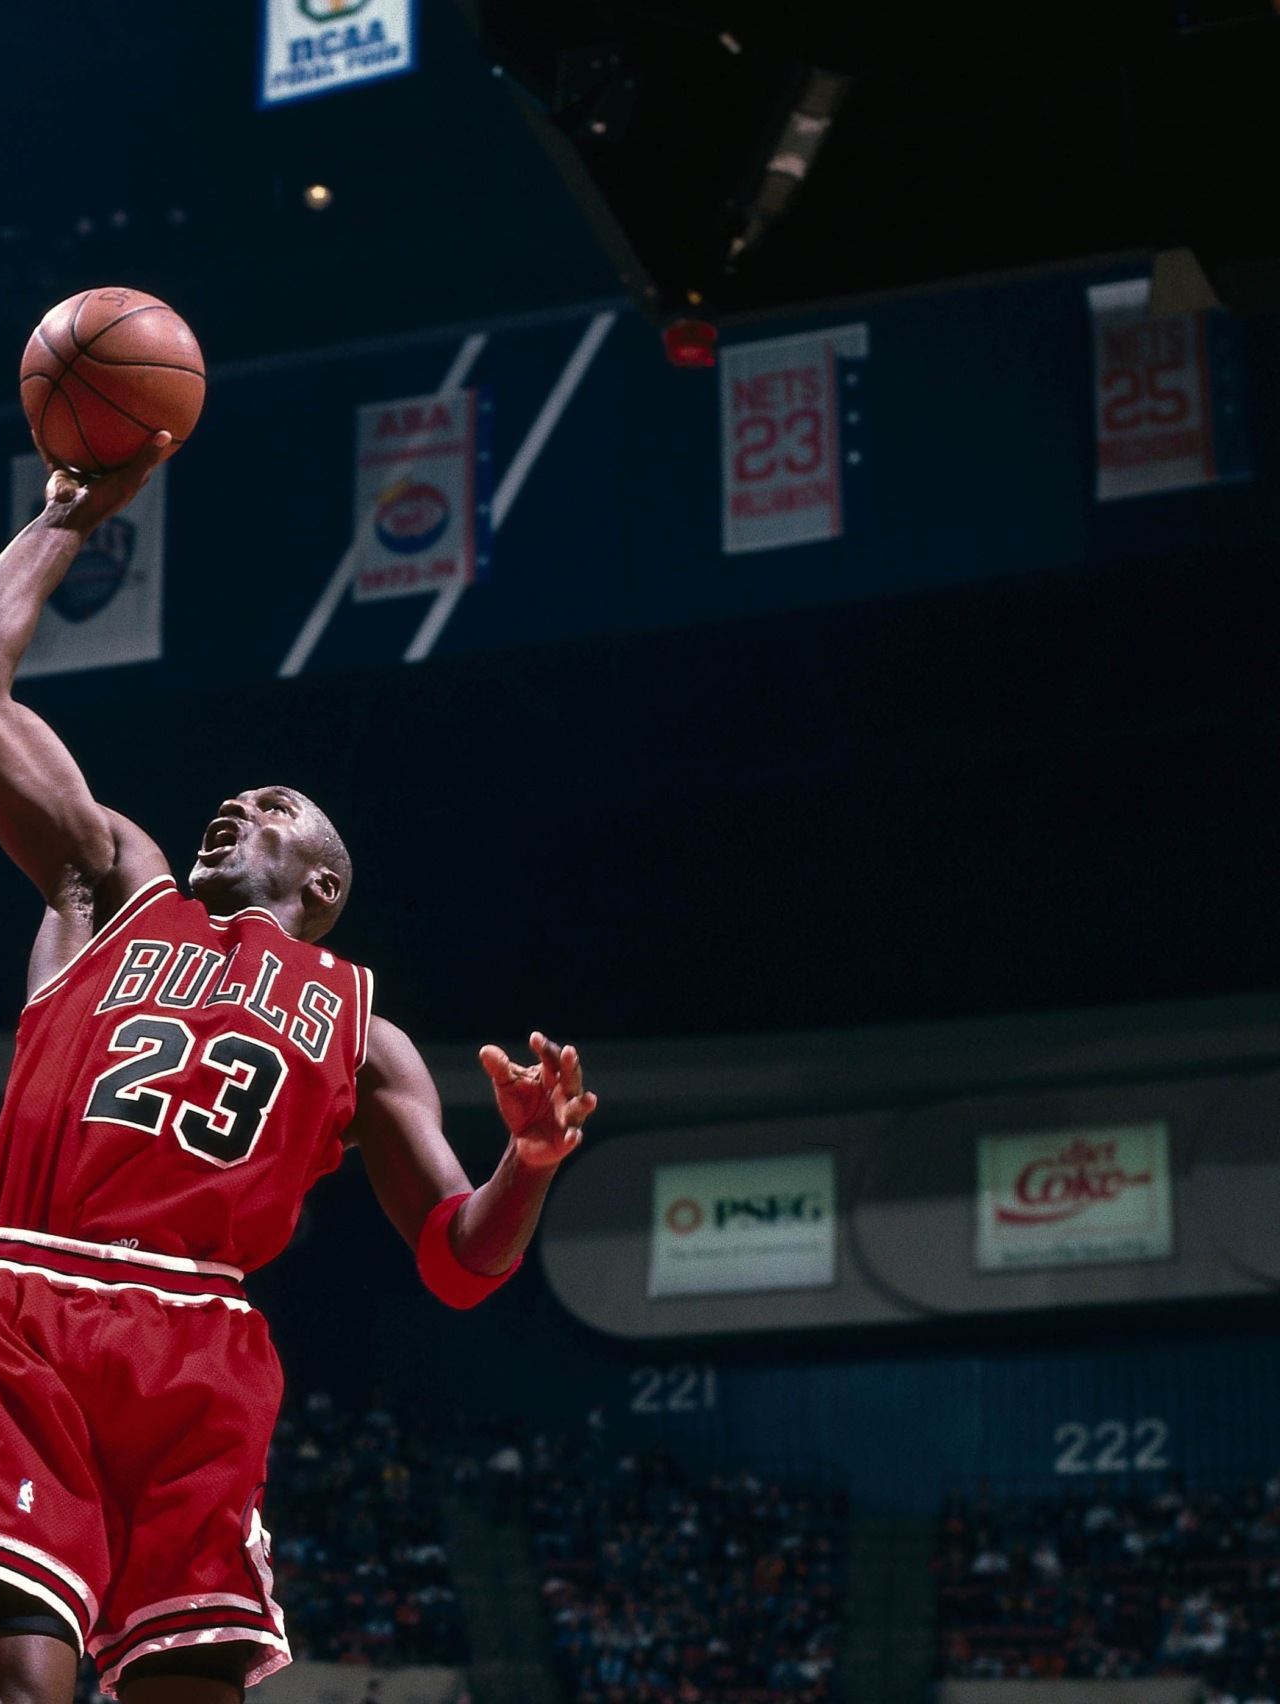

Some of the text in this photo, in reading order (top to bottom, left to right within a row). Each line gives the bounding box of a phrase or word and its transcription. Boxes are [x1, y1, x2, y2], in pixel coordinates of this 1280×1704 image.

[732, 365, 821, 412] NETS
[1100, 361, 1190, 431] 25
[734, 407, 823, 483] 23
[93, 939, 342, 1062] BULLS
[81, 1014, 289, 1170] 23
[628, 1363, 718, 1414] 221
[1054, 1417, 1170, 1475] 222
